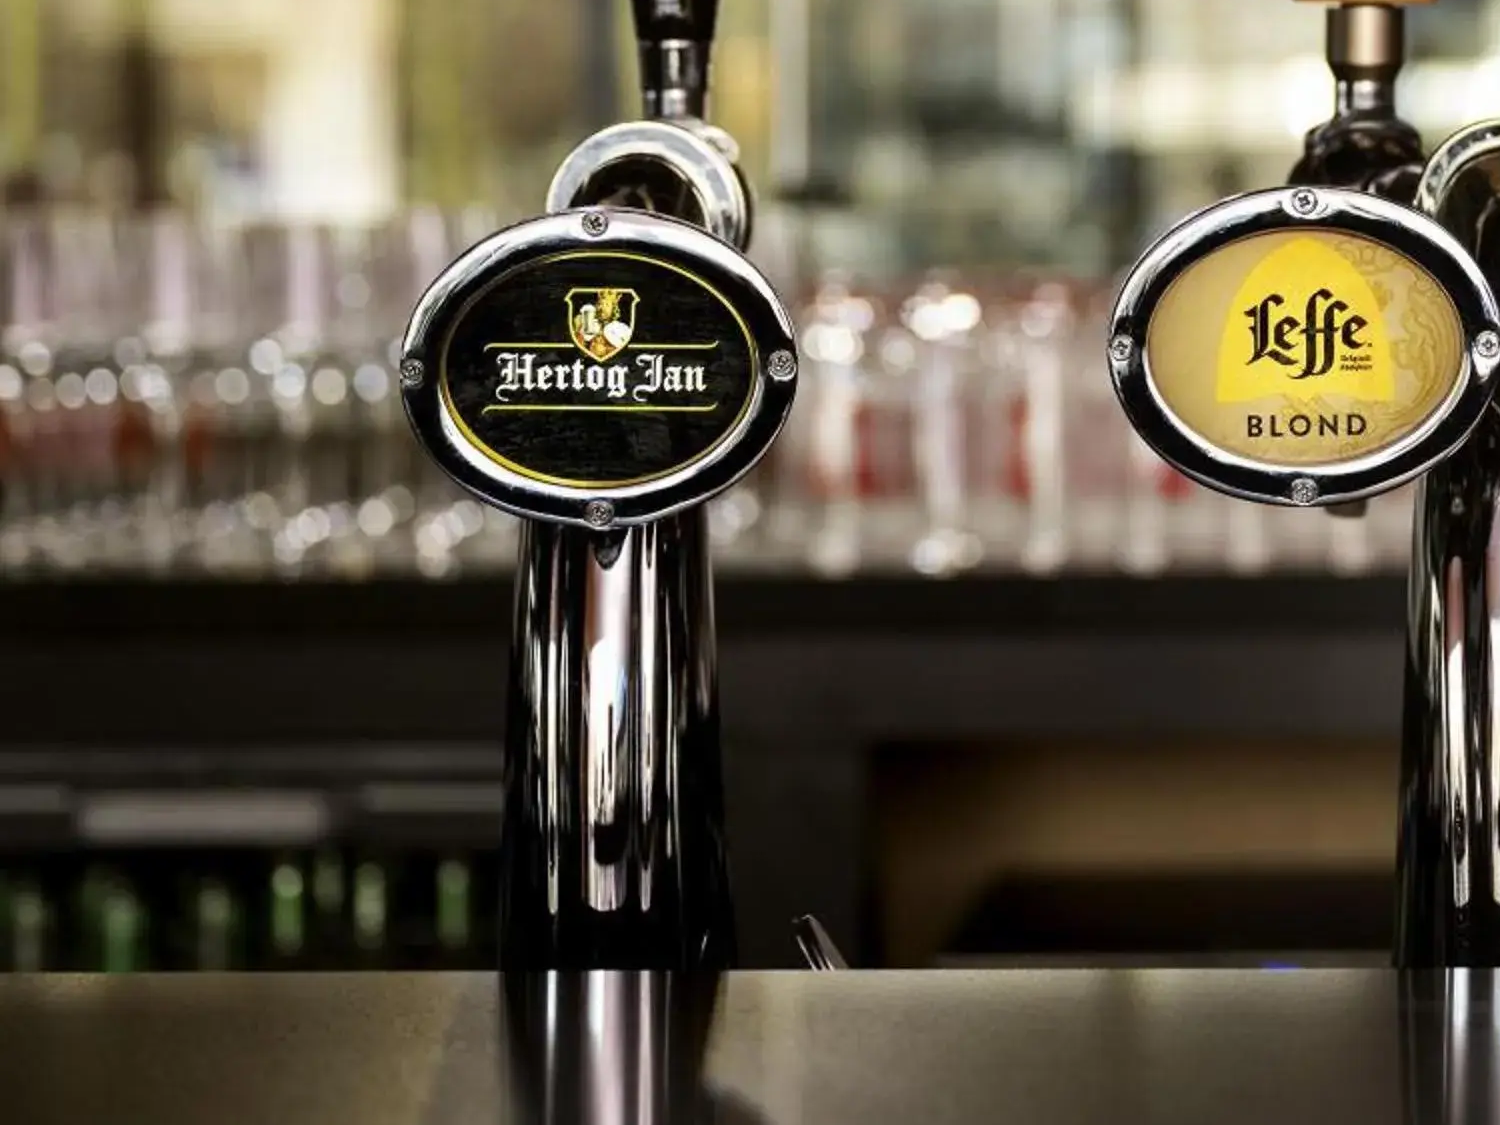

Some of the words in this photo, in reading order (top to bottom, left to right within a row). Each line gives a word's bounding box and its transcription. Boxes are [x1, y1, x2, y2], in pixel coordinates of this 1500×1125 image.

[1243, 288, 1370, 379] Leffe
[496, 352, 627, 402] Hertog
[633, 354, 707, 402] Jan
[1246, 414, 1367, 437] BLOND
